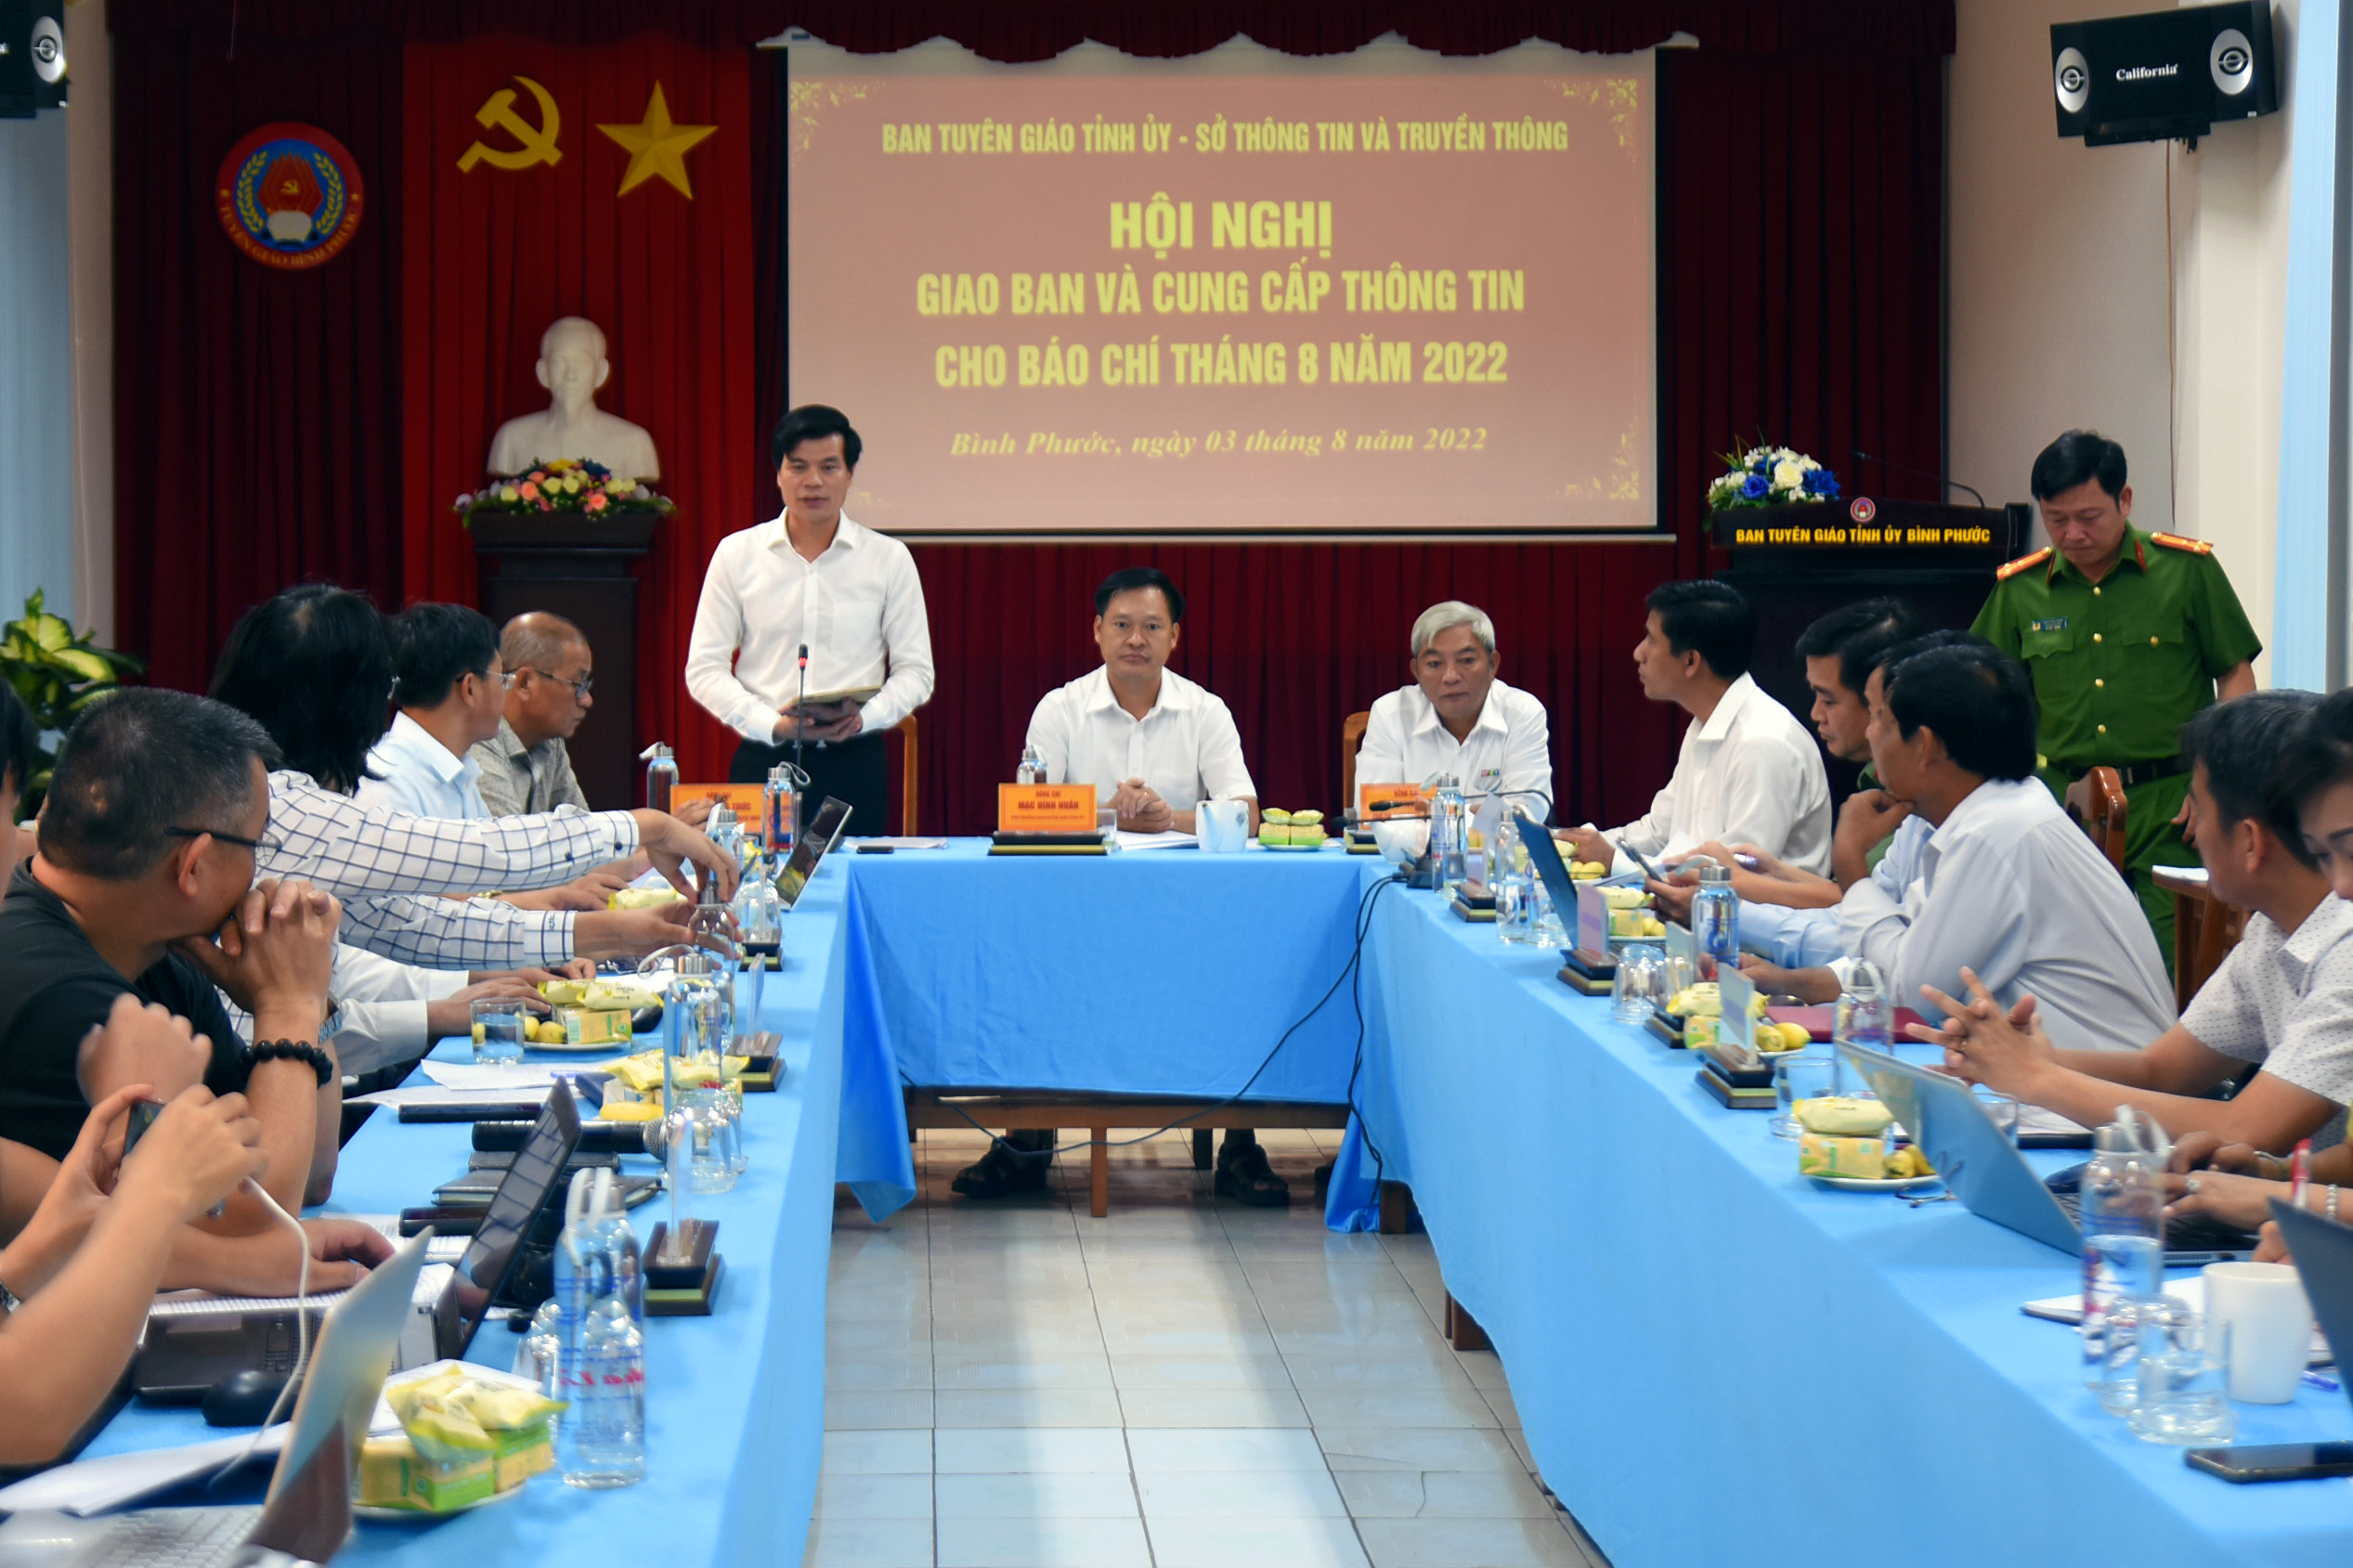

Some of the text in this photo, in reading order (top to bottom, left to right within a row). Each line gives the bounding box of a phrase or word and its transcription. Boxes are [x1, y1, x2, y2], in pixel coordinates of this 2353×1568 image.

[2116, 63, 2178, 82] California
[882, 123, 932, 153] BAN
[938, 117, 1013, 153] TUYÊN
[1020, 117, 1075, 153] GIÁO
[1082, 113, 1136, 152] TỈNH
[1143, 113, 1172, 153] ỦY
[1196, 113, 1228, 153] SỞ
[1233, 116, 1310, 152] THÔNG
[1317, 122, 1355, 151] TIN
[1361, 115, 1391, 151] VÀ
[1397, 112, 1486, 151] TRUYỀN
[1492, 115, 1569, 150] THÔNG
[1111, 191, 1332, 260] HỘI NGHỊ
[916, 256, 1525, 316] GIAO BAN VÀ CUNG CẤP THÔNG TIN
[935, 333, 1509, 387] CHO BÁO CHÍ THÁNG 8 NĂM 2022
[950, 427, 1488, 458] Bình Phước, ngày 03 tháng 8 năm 2022
[1736, 524, 1991, 543] BAN TUYÊN GIÁO TỈNH ỦY BÌNH PHƯỚC
